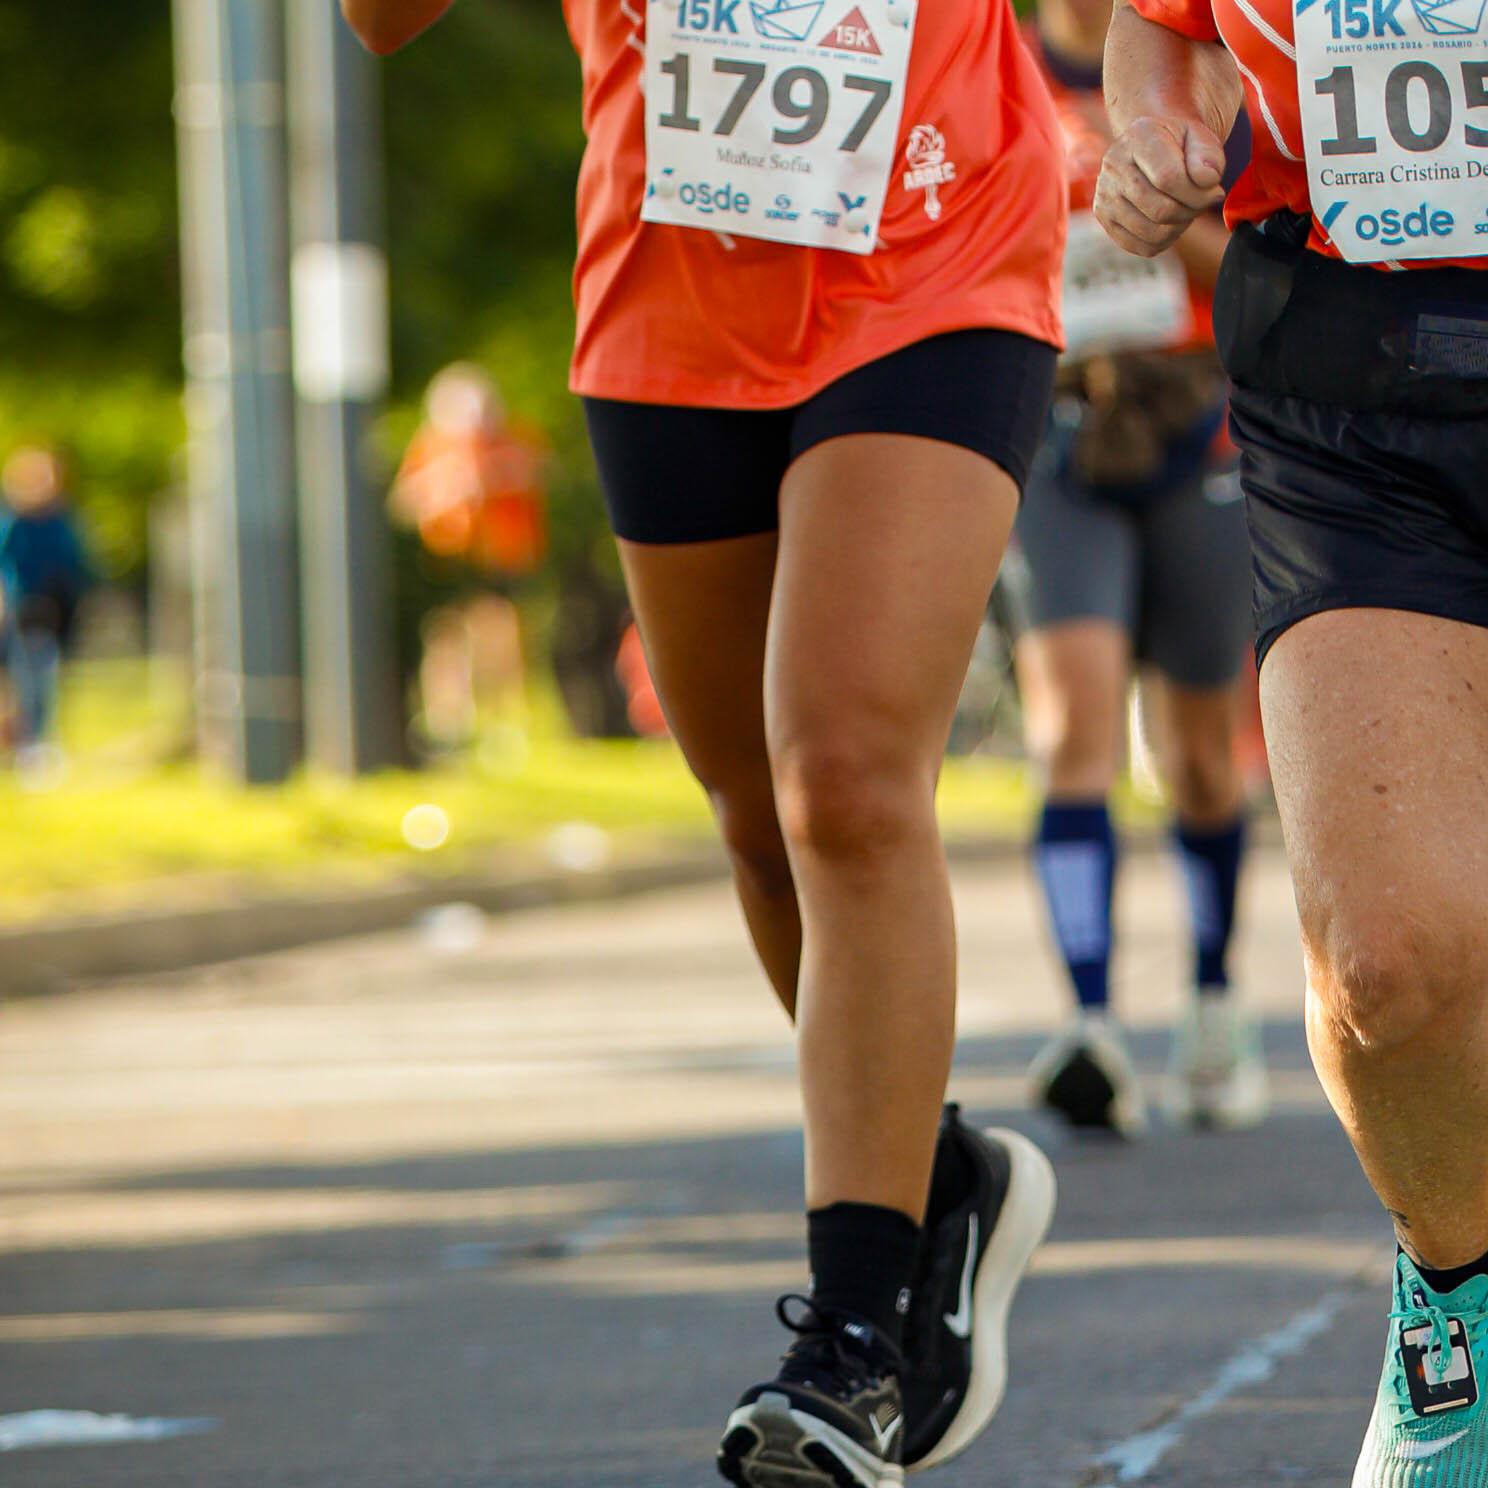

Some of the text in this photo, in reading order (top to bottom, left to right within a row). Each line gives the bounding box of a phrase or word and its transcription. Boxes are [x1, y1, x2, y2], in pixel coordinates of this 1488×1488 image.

[835, 25, 871, 49] 15K
[1326, 44, 1363, 53] PUERTO
[1366, 42, 1397, 52] NORTE
[1432, 39, 1473, 49] ROSARIO
[657, 52, 893, 152] 1797
[1320, 169, 1385, 187] Carrara
[1390, 163, 1461, 183] Cristina
[679, 181, 750, 213] osde
[1355, 201, 1455, 246] osde
